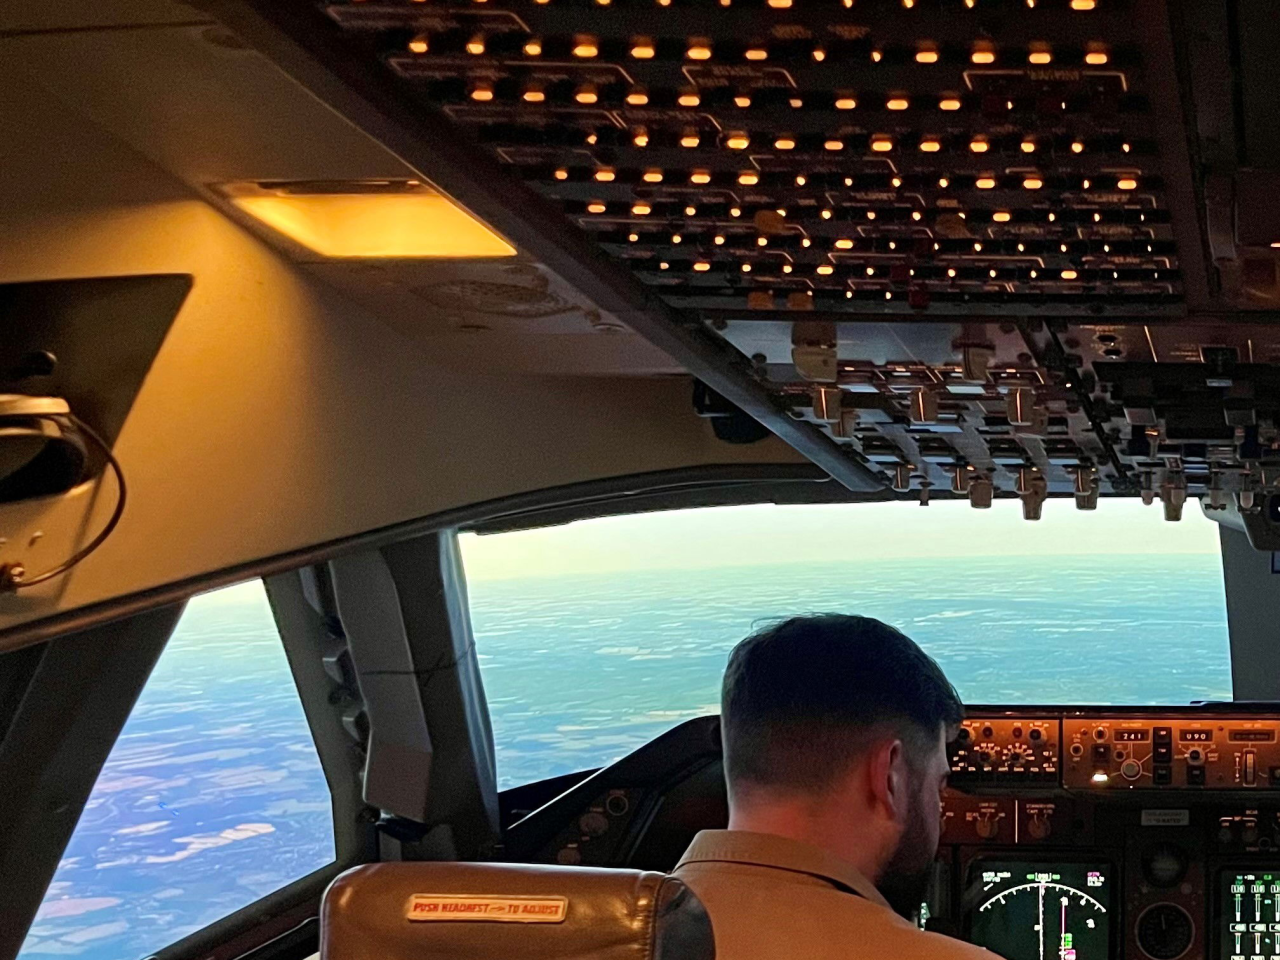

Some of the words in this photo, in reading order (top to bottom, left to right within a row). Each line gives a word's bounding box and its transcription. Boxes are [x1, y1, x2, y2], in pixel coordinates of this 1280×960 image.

[413, 903, 438, 912] PUSH
[441, 903, 490, 913] HEADREST
[507, 904, 520, 914] TO
[522, 905, 561, 914] ADJUST
